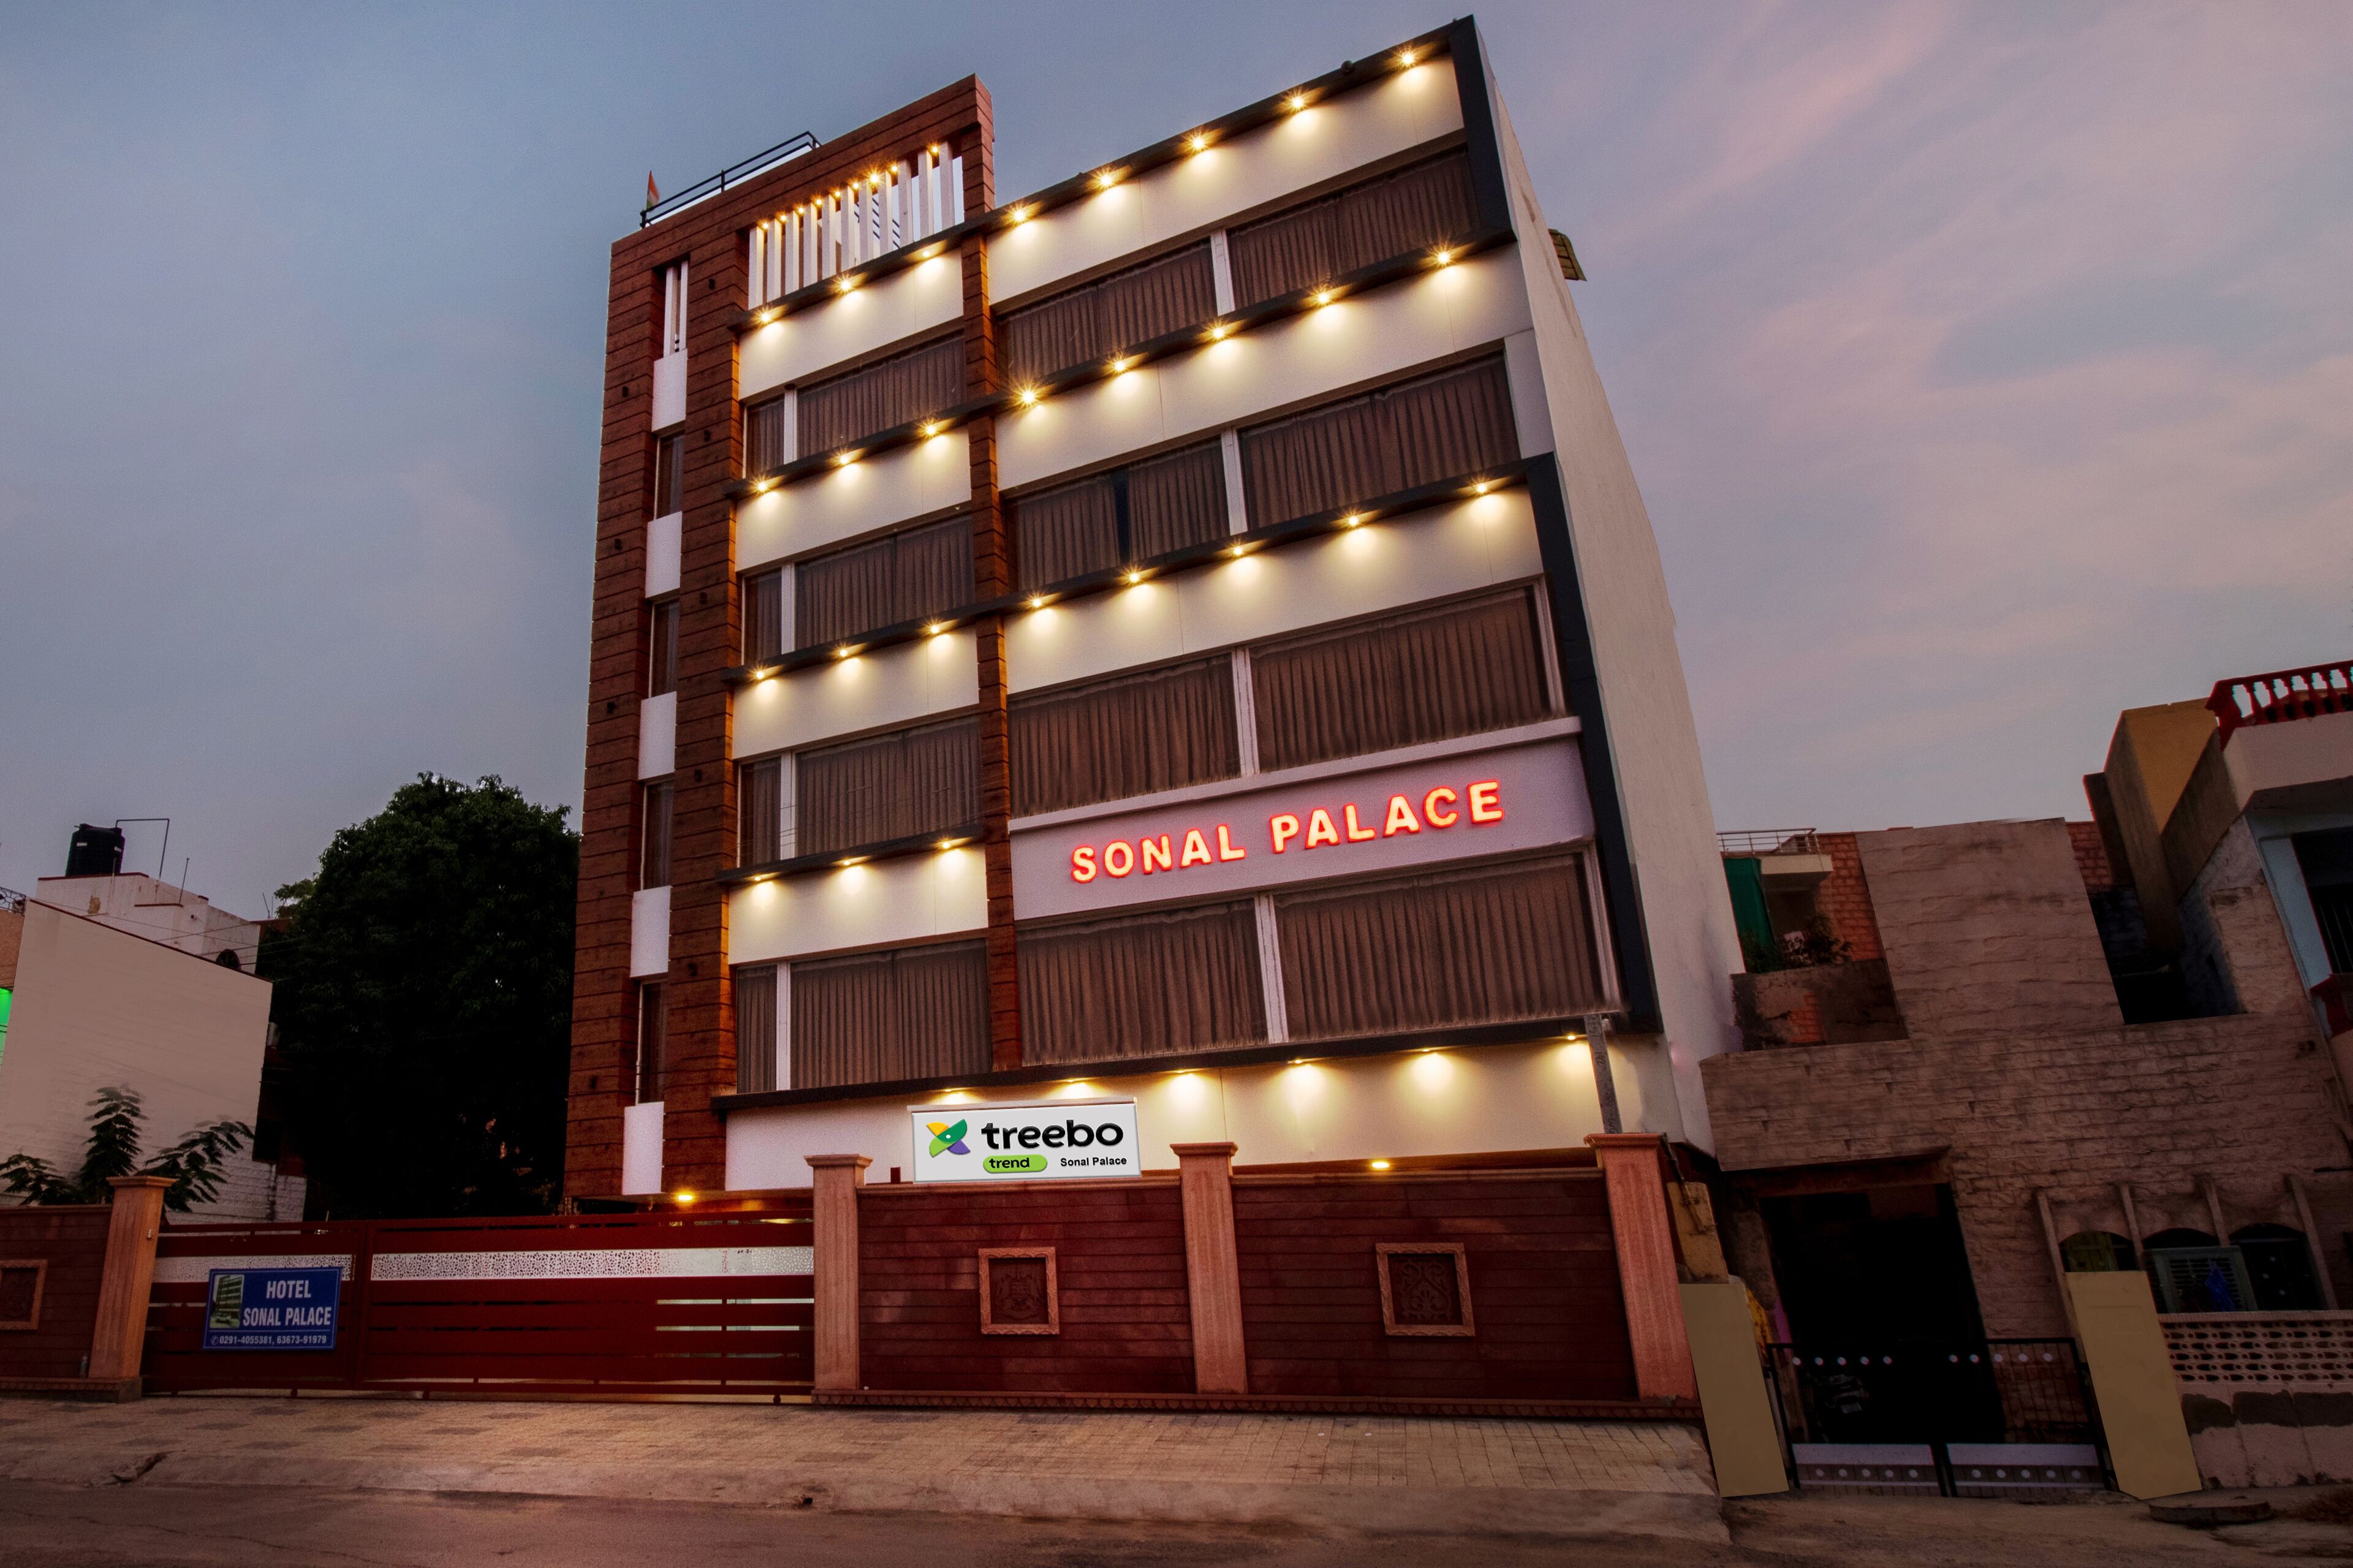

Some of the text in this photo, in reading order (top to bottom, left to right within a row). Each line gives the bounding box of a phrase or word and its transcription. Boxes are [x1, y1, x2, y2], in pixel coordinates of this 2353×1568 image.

[1071, 779, 1504, 883] SONAL PALACE
[981, 1119, 1124, 1149] treebo
[989, 1157, 1029, 1168] trend
[1060, 1156, 1127, 1167] Sonal Palace
[266, 1280, 311, 1299] HOTEL
[243, 1306, 332, 1327] SONAL PALACE
[276, 1335, 327, 1344] 63673-91979
